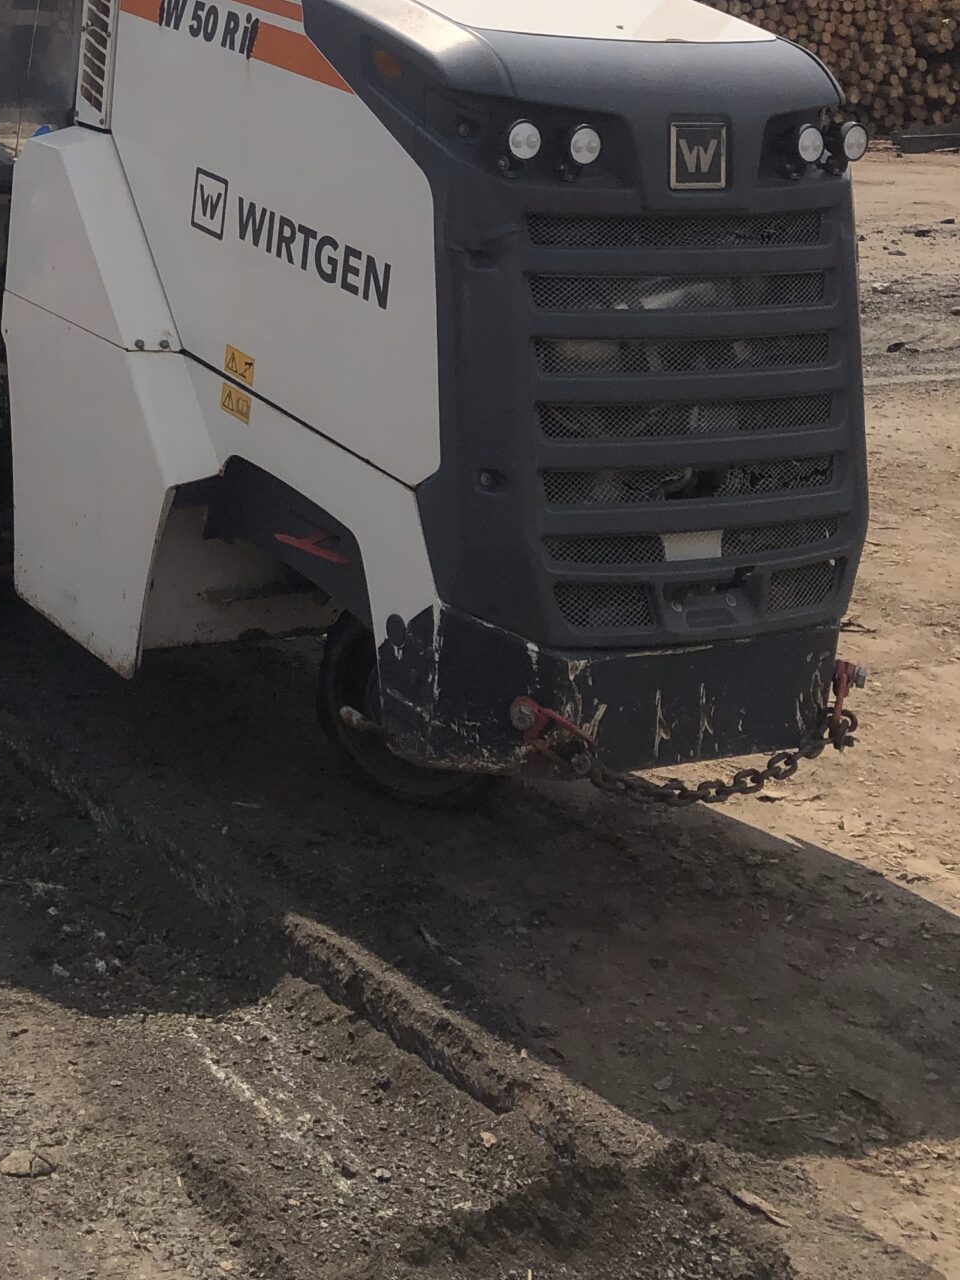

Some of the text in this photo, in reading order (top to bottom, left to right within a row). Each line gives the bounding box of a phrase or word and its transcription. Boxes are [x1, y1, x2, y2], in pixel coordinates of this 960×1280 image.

[189, 0, 219, 43] 50
[678, 138, 719, 174] W
[198, 183, 392, 310] W WIRTGEN
